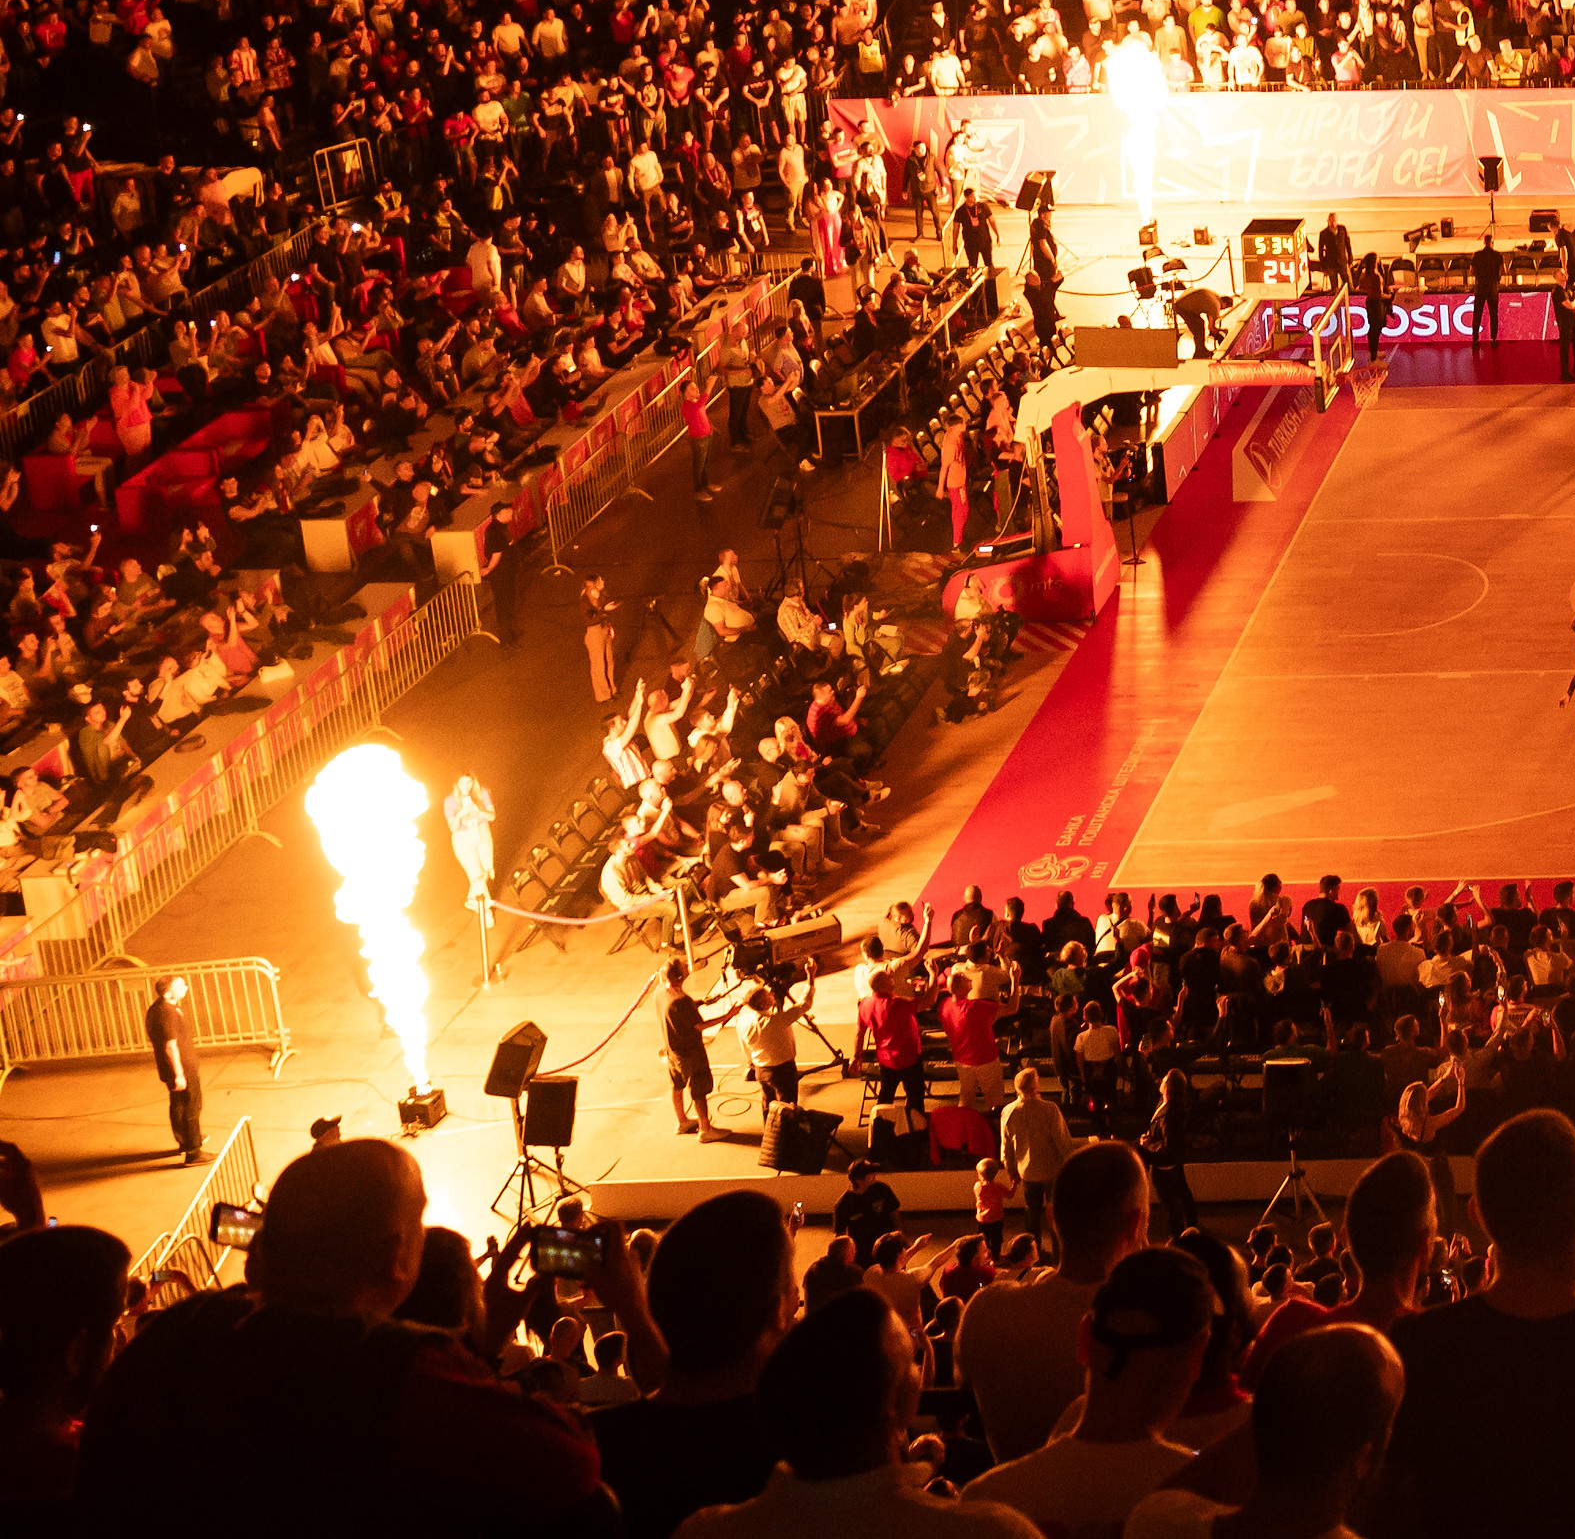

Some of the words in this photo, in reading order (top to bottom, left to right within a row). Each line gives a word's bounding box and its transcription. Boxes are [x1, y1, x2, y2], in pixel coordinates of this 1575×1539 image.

[1393, 144, 1449, 189] СЕ!
[1254, 236, 1294, 255] 5:34
[1262, 260, 1296, 284] 24
[1261, 295, 1485, 338] TEODOSIĆ
[1268, 406, 1303, 460] TURKISH
[1055, 814, 1087, 847] БАНКА
